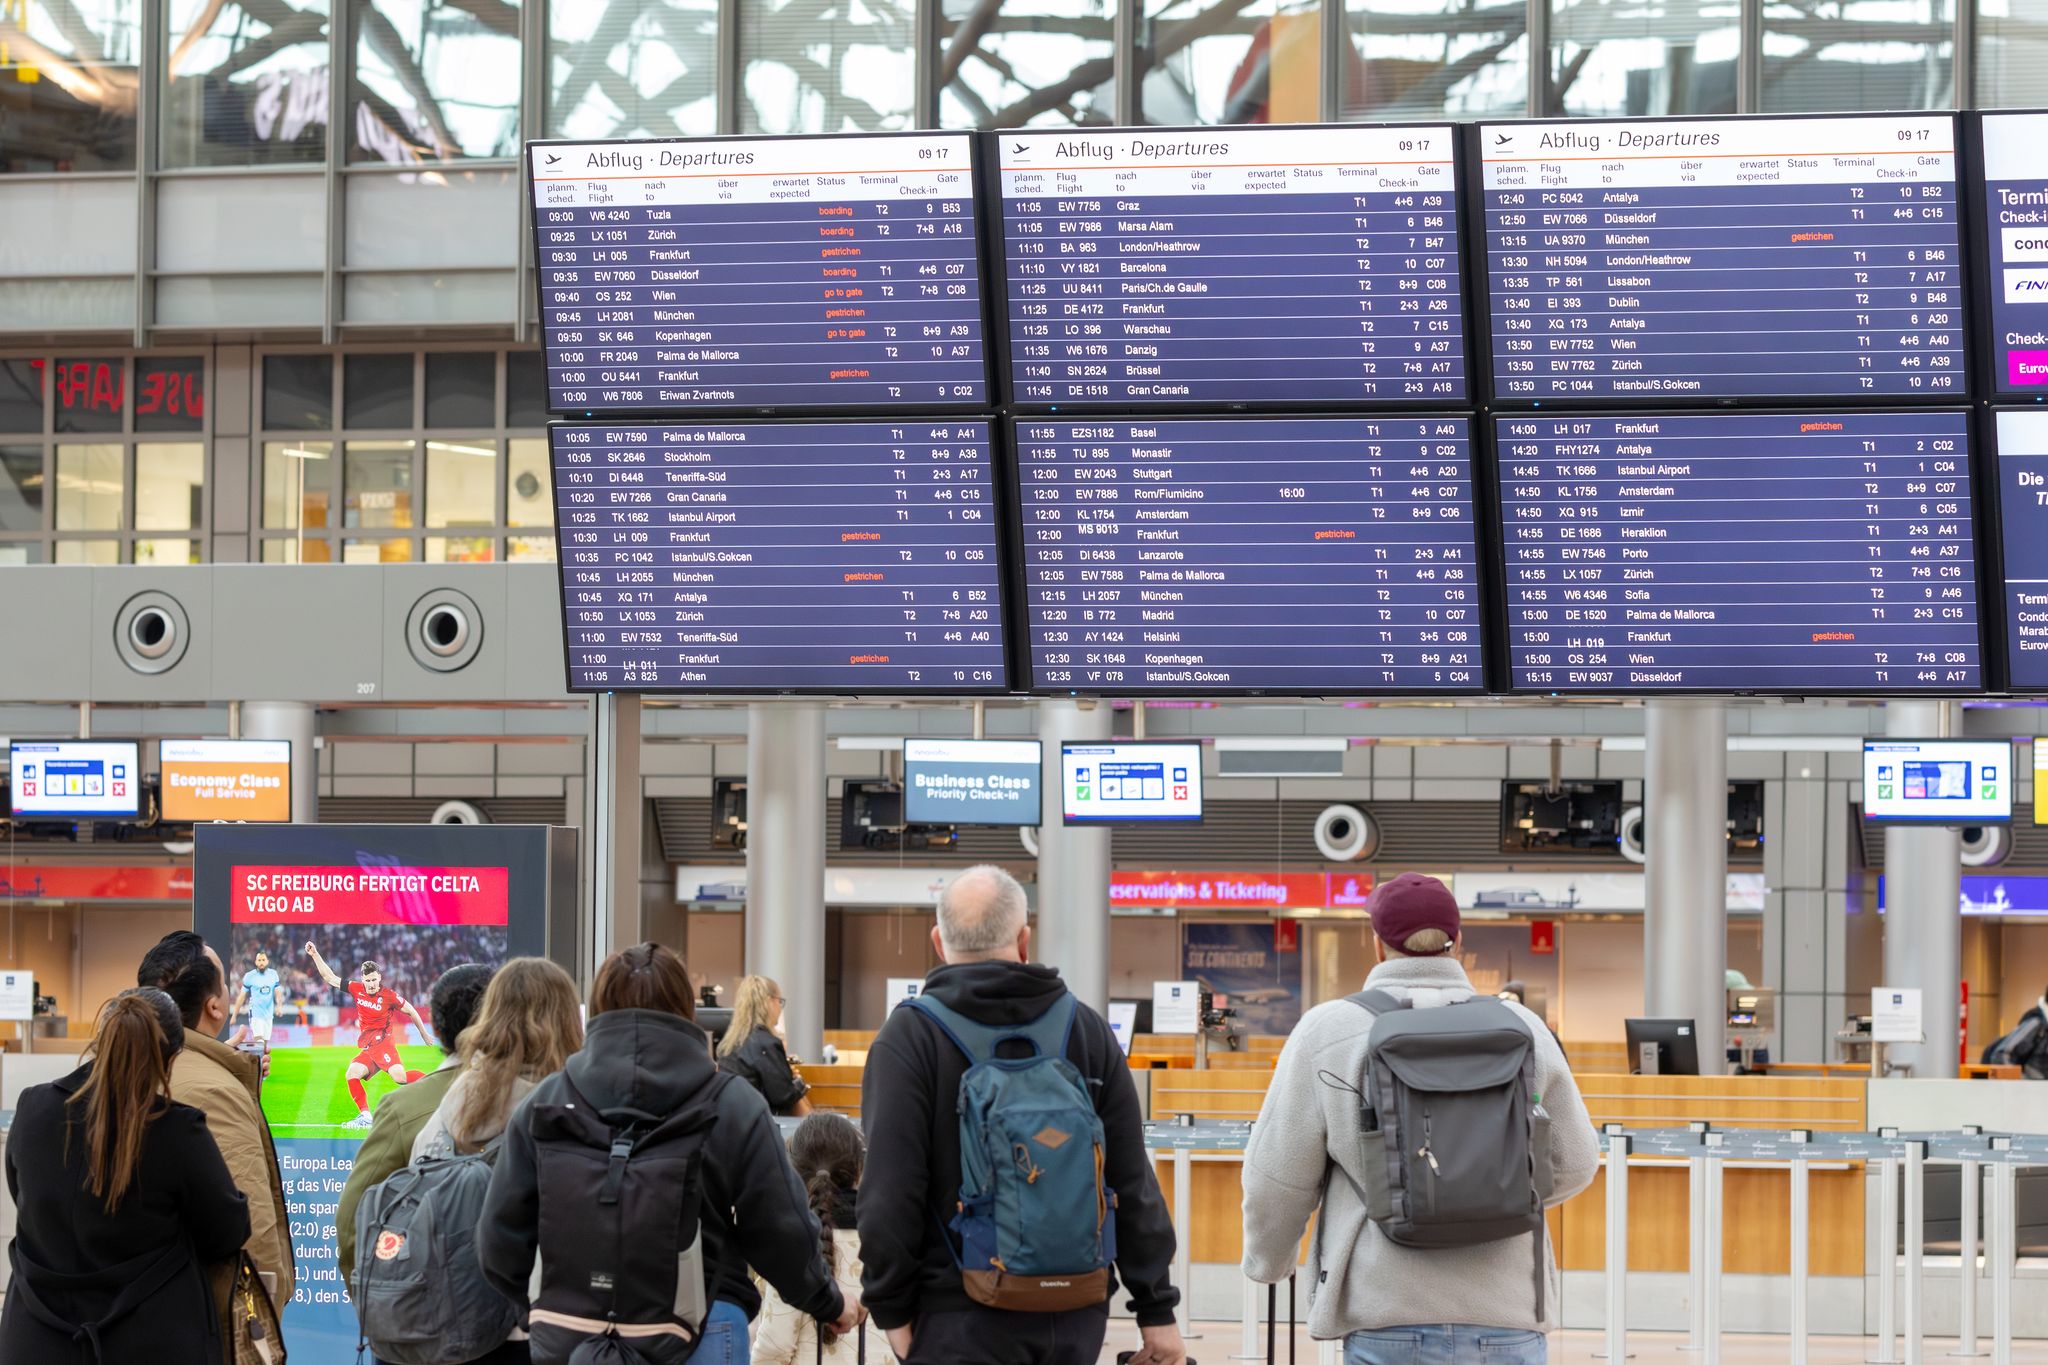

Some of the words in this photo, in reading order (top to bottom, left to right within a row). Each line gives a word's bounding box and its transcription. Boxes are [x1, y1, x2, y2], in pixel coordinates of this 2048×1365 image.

[1540, 132, 1600, 152] Abflug
[1618, 131, 1720, 151] Departures
[1898, 130, 1912, 141] 09
[1916, 130, 1930, 141] 17
[1055, 141, 1113, 161] Abflug
[1131, 140, 1229, 160] Departures
[1399, 140, 1413, 151] 09
[1417, 140, 1430, 151] 17
[586, 152, 643, 171] Abflug
[660, 150, 754, 170] Departures
[918, 148, 932, 160] 09
[936, 148, 949, 159] 17
[547, 183, 578, 194] planm.
[588, 182, 608, 193] Flug
[644, 181, 666, 190] nach
[718, 179, 739, 188] über
[772, 178, 810, 187] erwartet
[816, 176, 846, 186] Status
[859, 175, 899, 185] Terminal
[937, 173, 959, 183] Gate
[548, 194, 576, 204] sched.
[588, 194, 614, 204] Flight
[645, 193, 655, 201] to
[718, 192, 732, 200] via
[770, 189, 810, 200] expected
[899, 186, 938, 196] Check-in
[1500, 215, 1526, 226] 12:50
[1543, 214, 1562, 225] EW
[1563, 214, 1588, 225] 7066
[1604, 213, 1657, 224] Düsseldorf
[1851, 209, 1864, 220] T1
[1894, 208, 1914, 219] 4+6
[1922, 208, 1943, 218] C15
[550, 232, 576, 242] 09:25
[591, 231, 605, 241] LX
[606, 231, 627, 241] 1051
[648, 230, 677, 240] Zürich
[821, 227, 855, 236] boarding
[877, 225, 890, 235] T2
[916, 224, 935, 234] 7+8
[943, 223, 962, 234] A18
[1119, 241, 1201, 252] London/Heathrow
[1020, 264, 1045, 274] 11:10
[1061, 263, 1076, 274] VY
[1078, 263, 1100, 273] 1821
[1121, 262, 1167, 273] Barcelona
[1357, 259, 1371, 270] T2
[1405, 259, 1417, 269] 10
[1425, 258, 1445, 269] C07
[1022, 305, 1048, 315] 11:25
[1064, 304, 1079, 315] DE
[1081, 304, 1104, 314] 4172
[1123, 304, 1165, 314] Frankfurt
[1360, 301, 1372, 311] T1
[1400, 300, 1419, 311] 2+3
[1428, 300, 1448, 310] A26
[556, 312, 581, 322] 09:45
[597, 312, 611, 322] LH
[612, 311, 634, 322] 2081
[654, 311, 695, 321] München
[826, 309, 865, 318] gestrichen
[560, 352, 584, 363] 10:00
[600, 352, 614, 362] FR
[616, 352, 639, 362] 2049
[657, 351, 686, 361] Palma
[688, 351, 699, 361] de
[701, 350, 740, 360] Mallorca
[885, 347, 898, 357] T2
[931, 346, 943, 357] 10
[952, 346, 970, 356] A37
[568, 453, 592, 463] 10:05
[608, 452, 622, 463] SK
[623, 452, 646, 463] 2646
[664, 452, 712, 462] Stockholm
[893, 450, 905, 460] T2
[932, 449, 950, 459] 8+9
[959, 449, 978, 459] A38
[2018, 472, 2044, 486] Die
[1134, 489, 1204, 499] Rom/Fiumicino
[1279, 488, 1305, 498] 16:00
[1515, 487, 1541, 497] 14:50
[1558, 487, 1572, 497] KL
[1574, 486, 1598, 497] 1756
[1619, 486, 1675, 496] Amsterdam
[1865, 483, 1879, 494] T2
[1907, 483, 1927, 493] 8+9
[1935, 483, 1956, 493] C07
[573, 533, 598, 543] 10:30
[614, 533, 627, 543] LH
[631, 533, 648, 542] 009
[670, 532, 711, 542] Frankfurt
[842, 533, 881, 541] gestrichen
[2017, 594, 2048, 604] Term
[1045, 654, 1070, 664] 12:30
[1087, 654, 1101, 664] SK
[1103, 654, 1126, 664] 1648
[1145, 654, 1203, 666] Kopenhagen
[1381, 654, 1394, 664] T2
[1422, 654, 1440, 664] 8+9
[1449, 654, 1468, 664] A21
[358, 683, 375, 694] 207
[170, 773, 236, 790] Economy
[240, 774, 280, 788] Class
[914, 774, 984, 788] Business
[988, 776, 1030, 789] Class
[195, 788, 214, 798] Full
[218, 788, 256, 798] Service
[927, 789, 967, 800] Priority
[970, 790, 1018, 800] Check-in
[247, 874, 268, 891] SC
[272, 875, 355, 892] FREIBURG
[360, 876, 428, 892] FERTIGT
[432, 876, 480, 892] CELTA
[1110, 881, 1196, 899] eservations
[1200, 882, 1212, 899] &
[1216, 882, 1287, 903] Ticketing
[247, 896, 288, 913] VIGO
[292, 896, 314, 913] AB
[283, 1155, 328, 1172] Europa
[331, 1156, 353, 1171] Lea
[297, 1178, 320, 1192] das
[295, 1244, 332, 1259] durch
[313, 1267, 336, 1281] und
[315, 1289, 339, 1303] den
